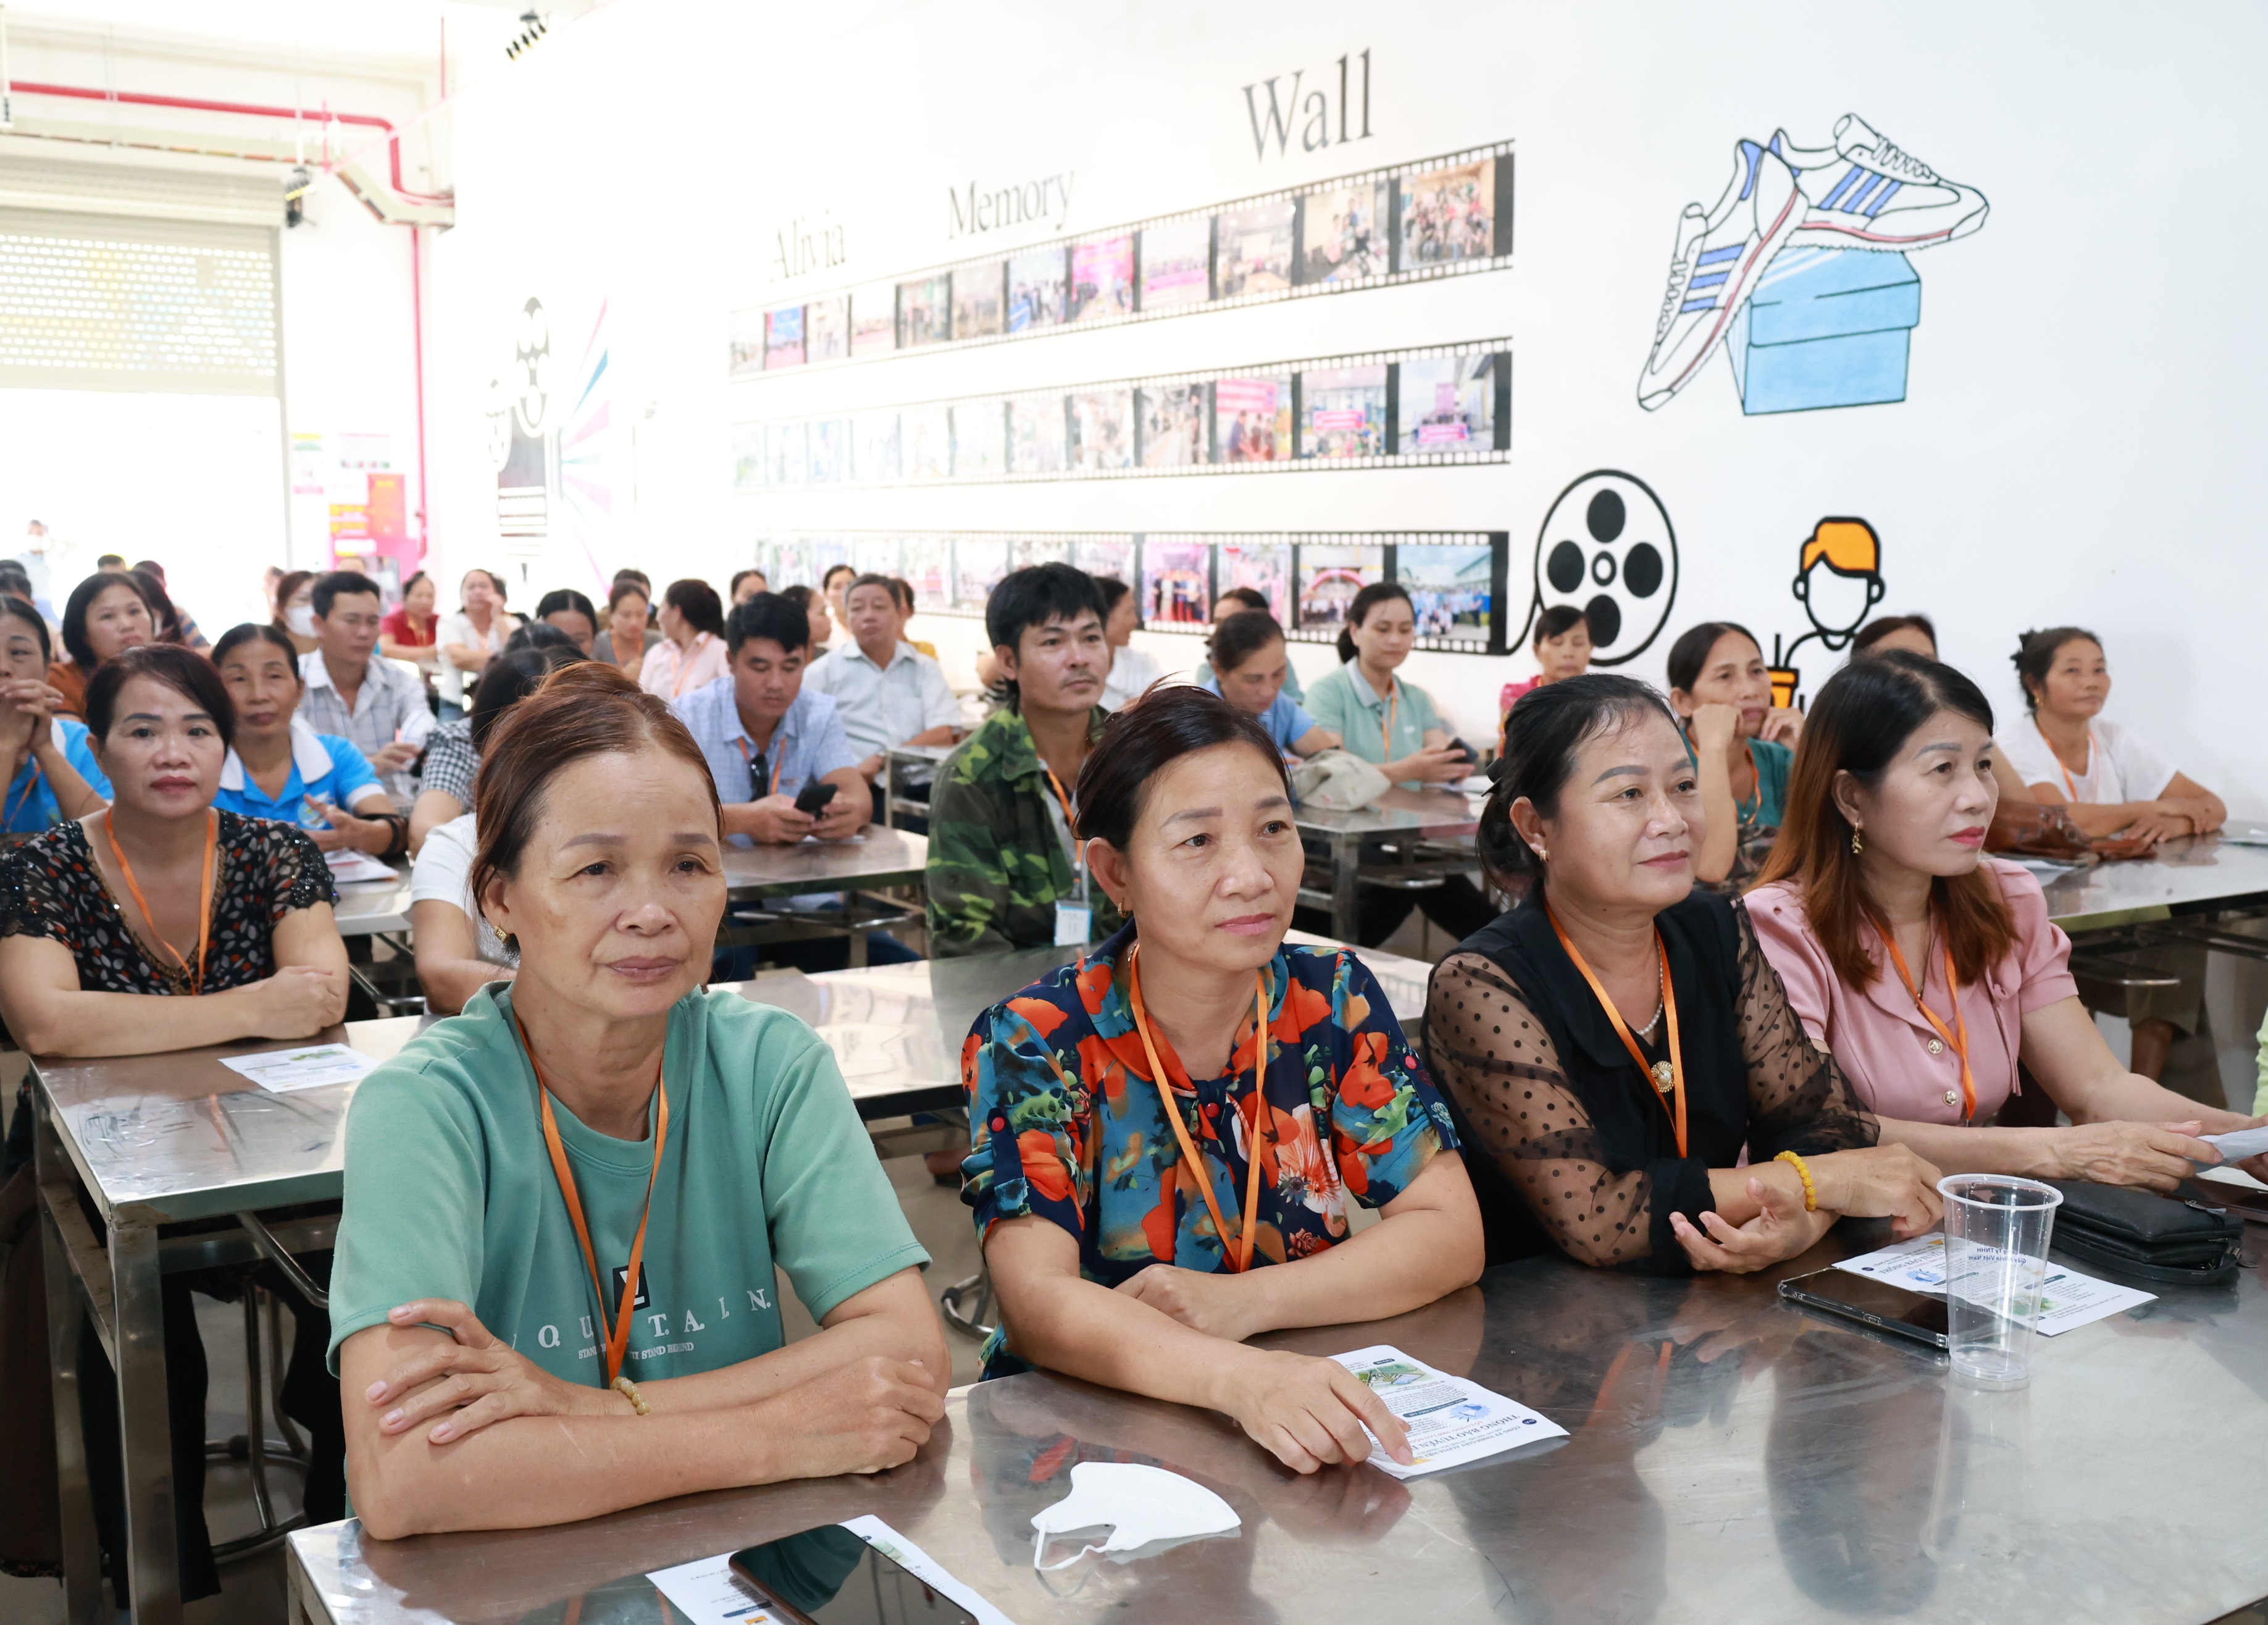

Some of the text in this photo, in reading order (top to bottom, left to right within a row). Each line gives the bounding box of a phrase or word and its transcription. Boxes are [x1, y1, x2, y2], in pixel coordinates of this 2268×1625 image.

[769, 46, 1375, 283] Alivia Memory Wall
[642, 1346, 666, 1359] STAND
[1481, 1415, 1520, 1430] THÔNG
[1457, 1428, 1481, 1437] BÁO
